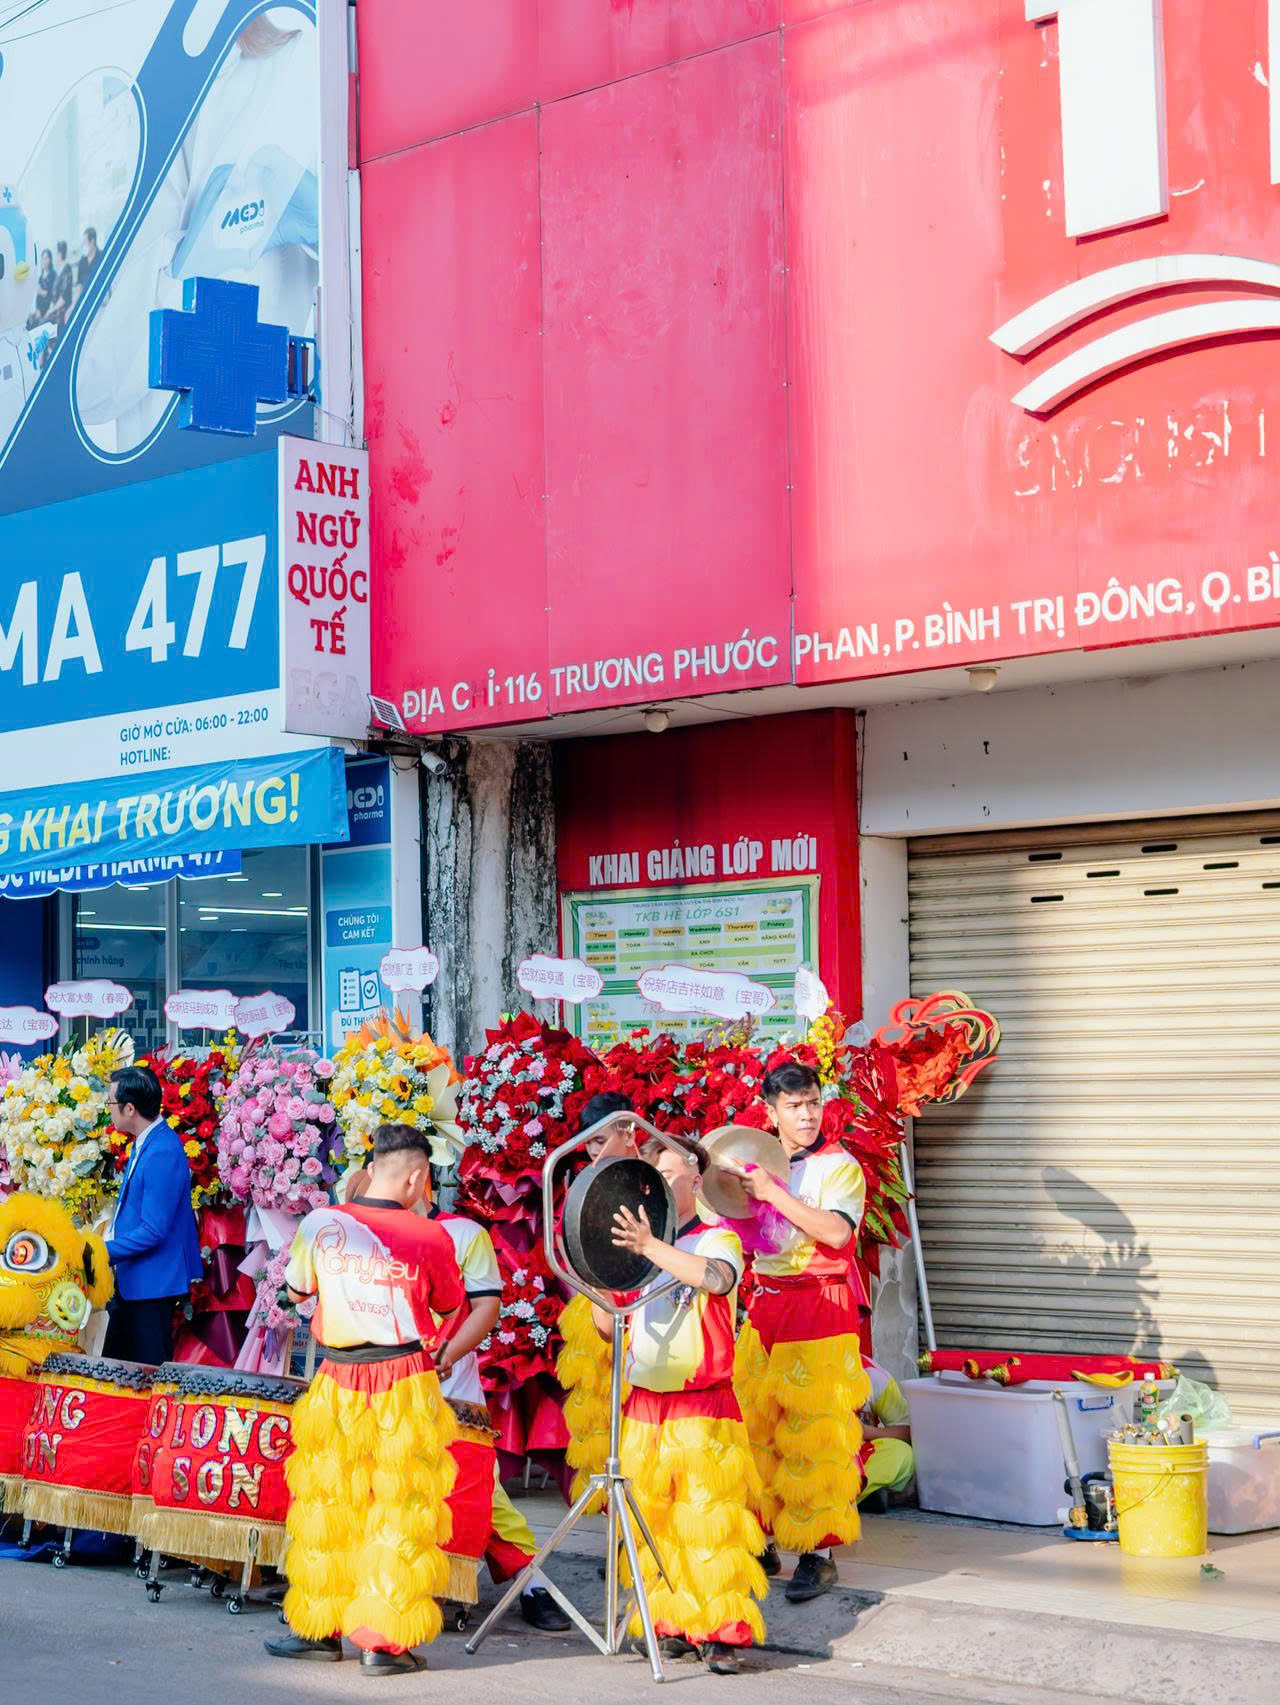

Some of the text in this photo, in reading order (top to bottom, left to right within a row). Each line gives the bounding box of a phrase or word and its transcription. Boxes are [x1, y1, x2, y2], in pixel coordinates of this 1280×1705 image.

[294, 458, 360, 500] ANH
[296, 509, 361, 549] NGỮ
[125, 534, 267, 664] 477
[287, 551, 368, 606] QUỐC
[310, 606, 348, 655] TẾ
[402, 685, 445, 724] ĐỊA
[503, 672, 542, 705] 116
[550, 652, 665, 697] TRƯƠNG
[674, 628, 779, 680] PHƯỚC
[1010, 594, 1065, 639] TRỊ
[1073, 577, 1196, 627] ĐÔNG,
[120, 724, 141, 744] GIỜ
[143, 720, 166, 742] MỞ
[195, 711, 227, 732] 06:00
[237, 706, 269, 727] 22:00
[120, 746, 171, 767] HOTLINE:
[18, 798, 106, 857] KHAI
[117, 771, 300, 845] TRƯƠNG!
[353, 809, 384, 822] pharma
[589, 831, 817, 886] KHAI GIẢNG LỚP MỚI
[338, 910, 380, 928] CHÚNG TÔI
[342, 924, 376, 941] CAM KẾT
[634, 905, 740, 922] TKB HÈ LỚP 6S1
[170, 1403, 291, 1461] LONG
[172, 1455, 266, 1509] SƠN
